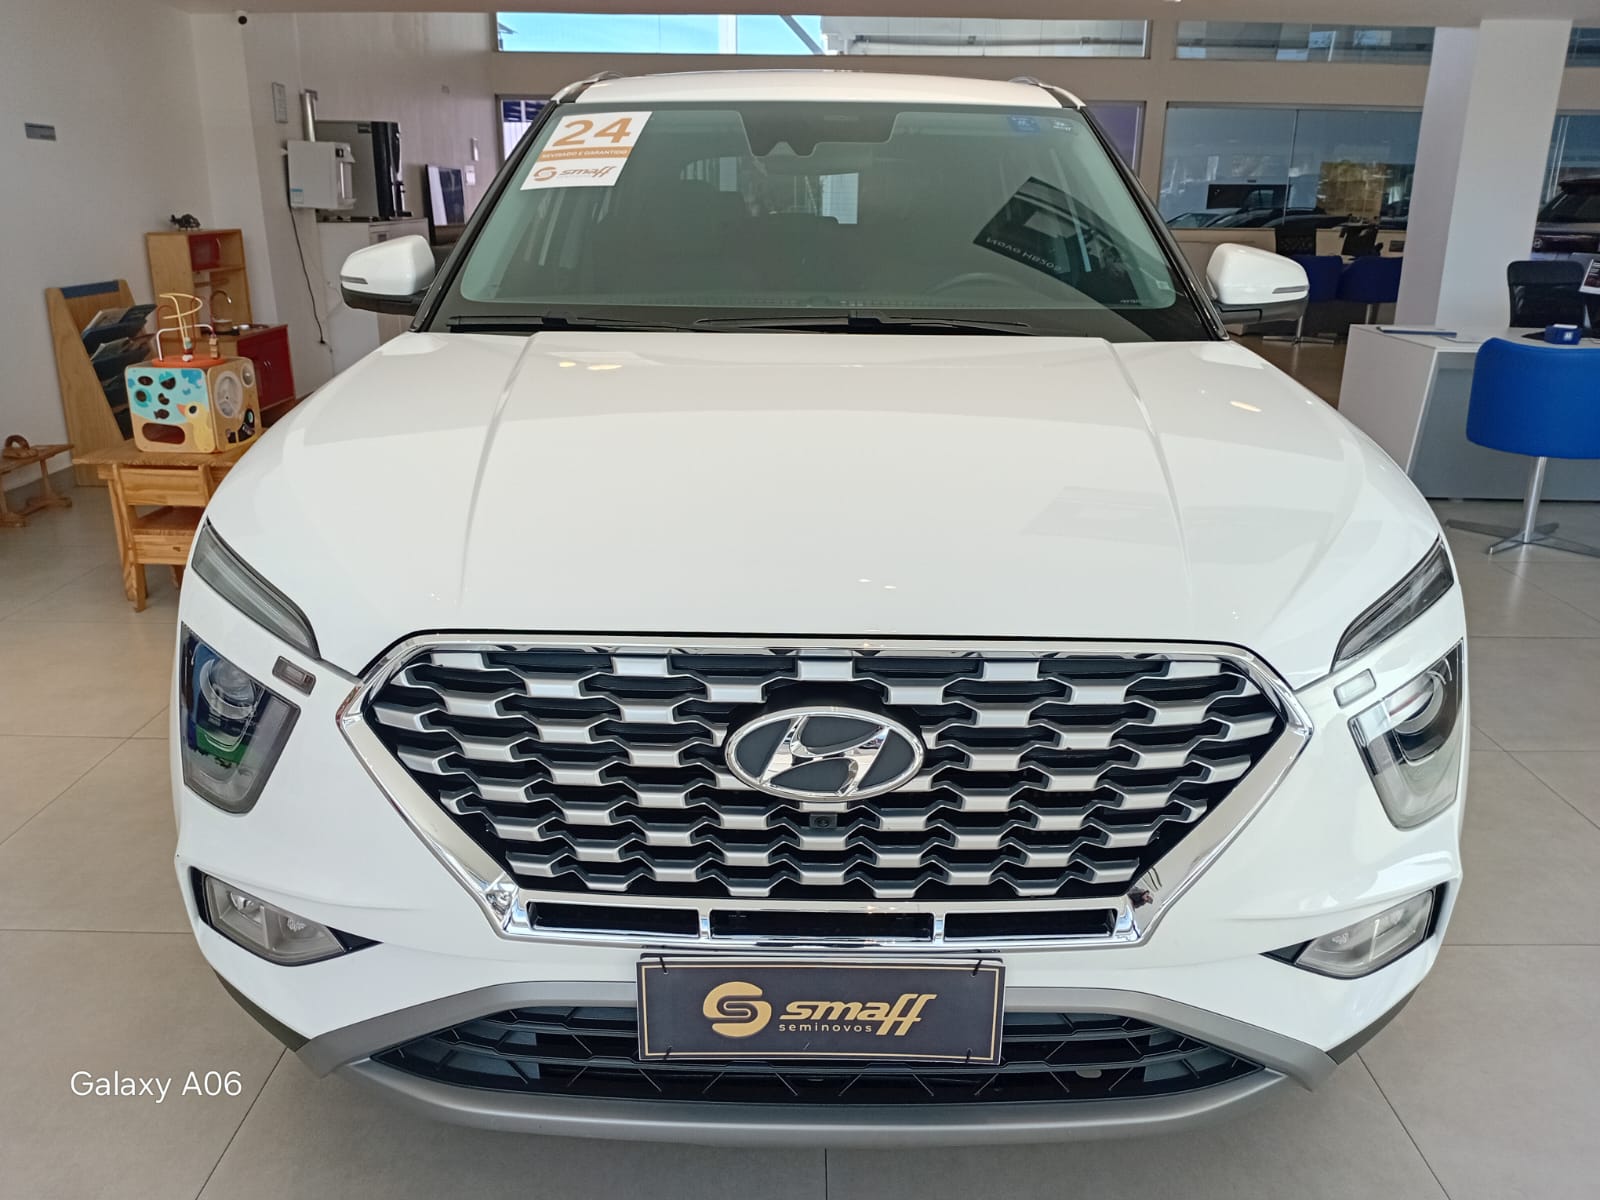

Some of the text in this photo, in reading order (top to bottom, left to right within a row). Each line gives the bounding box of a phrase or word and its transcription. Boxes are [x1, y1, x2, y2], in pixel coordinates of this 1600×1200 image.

[552, 118, 633, 147] 24
[778, 1022, 872, 1033] seminovos
[779, 993, 938, 1036] smaff
